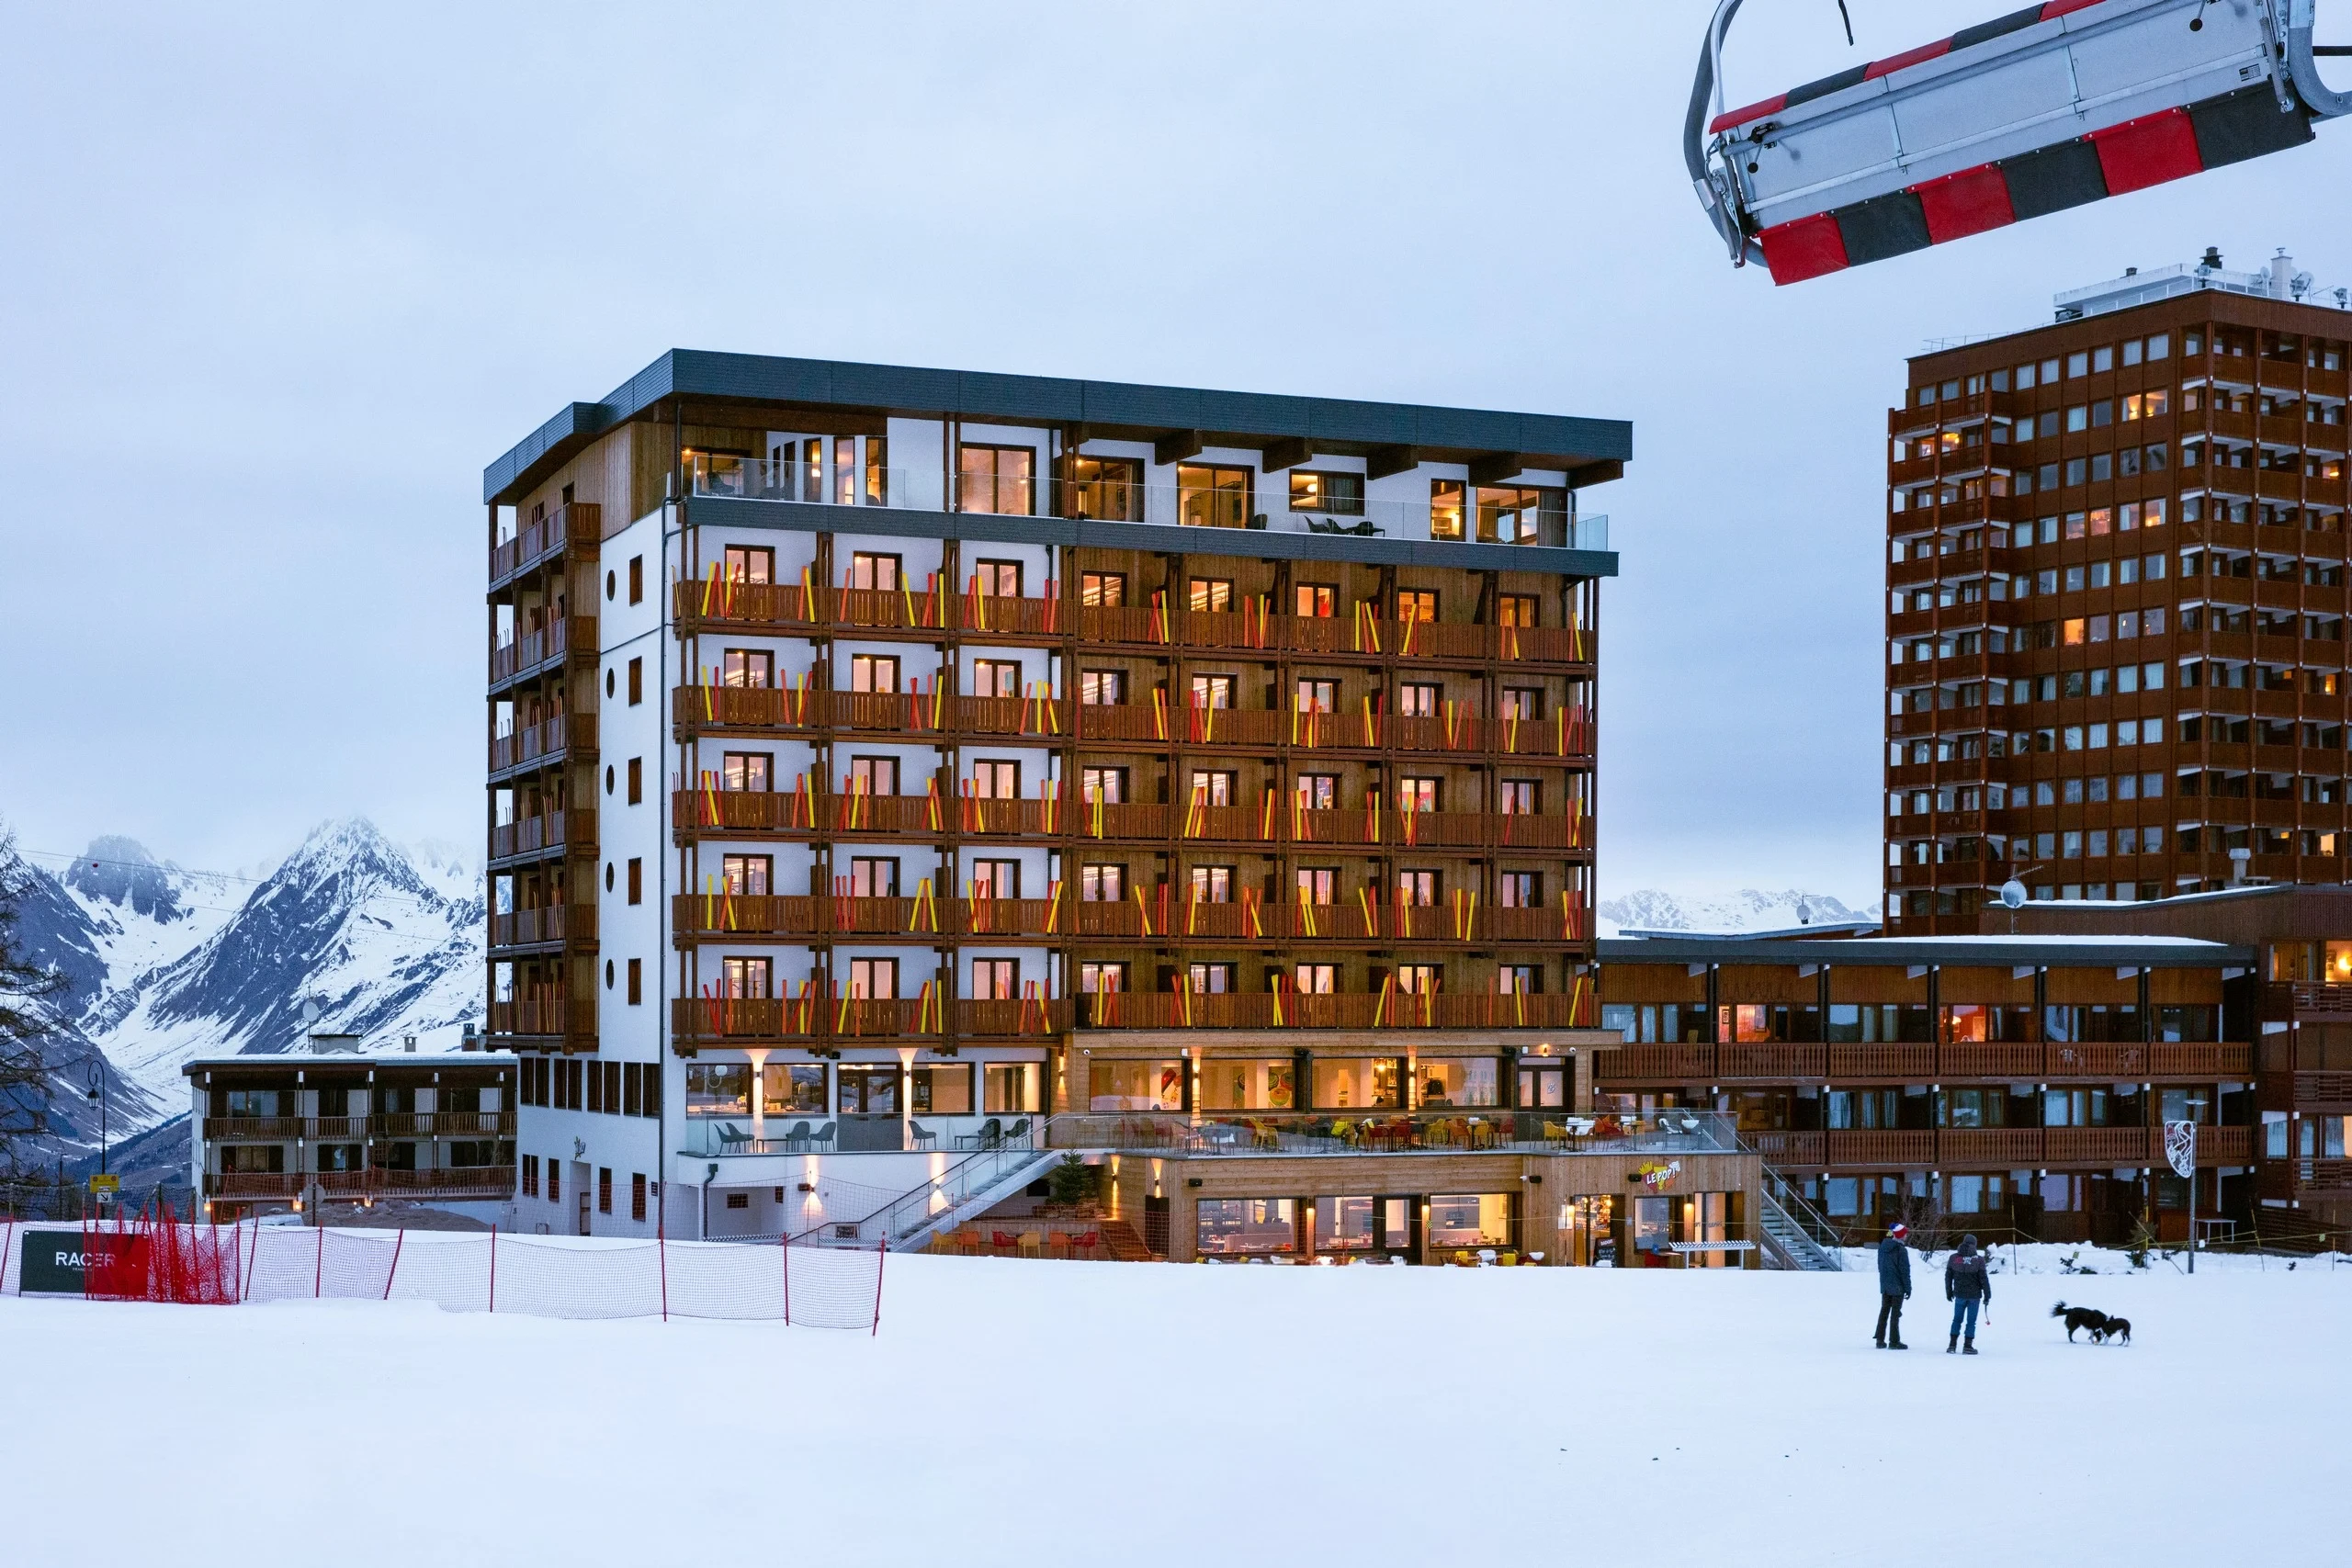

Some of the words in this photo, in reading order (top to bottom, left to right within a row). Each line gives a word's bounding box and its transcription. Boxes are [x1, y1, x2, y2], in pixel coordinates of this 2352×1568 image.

[1646, 1173, 1657, 1185] LE
[1657, 1168, 1676, 1182] POP!
[55, 1251, 116, 1267] RACER
